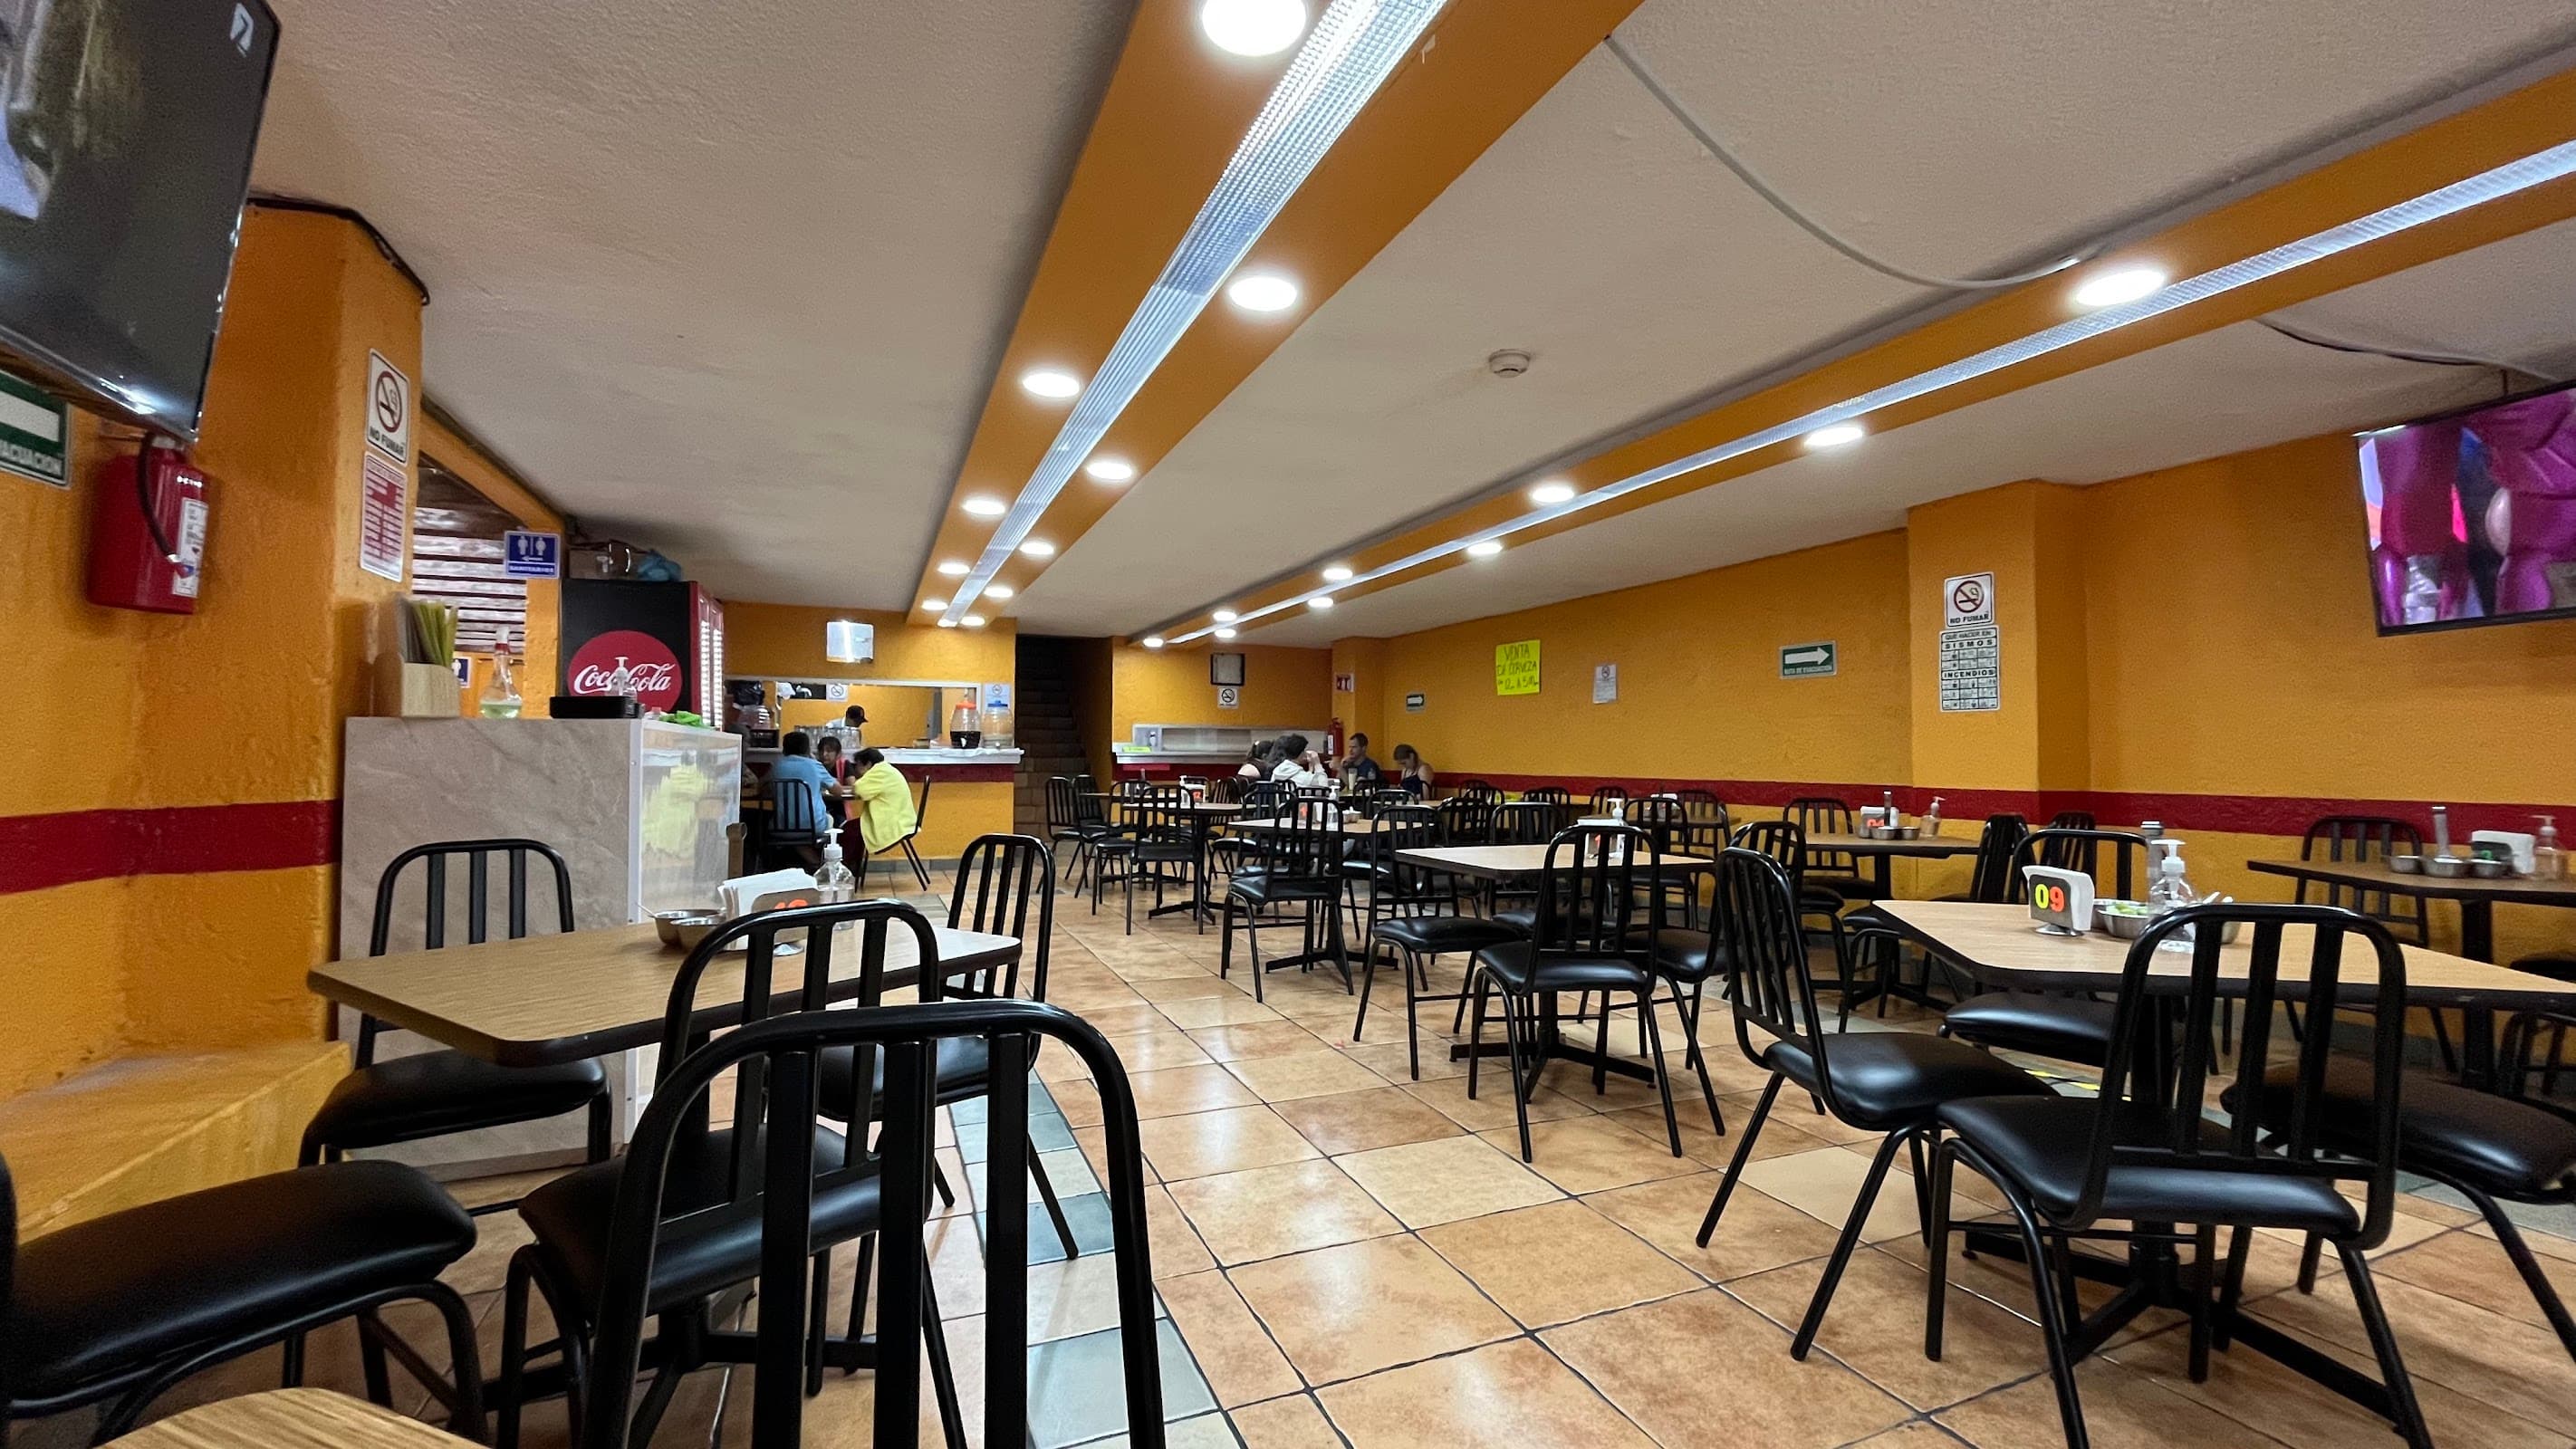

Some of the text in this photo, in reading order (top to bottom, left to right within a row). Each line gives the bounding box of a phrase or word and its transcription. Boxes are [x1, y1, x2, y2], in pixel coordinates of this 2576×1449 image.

[1963, 614, 1989, 622] FUMAR
[1945, 639, 1993, 648] SISMOS
[1504, 644, 1530, 660] VENTA
[574, 664, 676, 694] CocCola
[2034, 883, 2066, 913] 09
